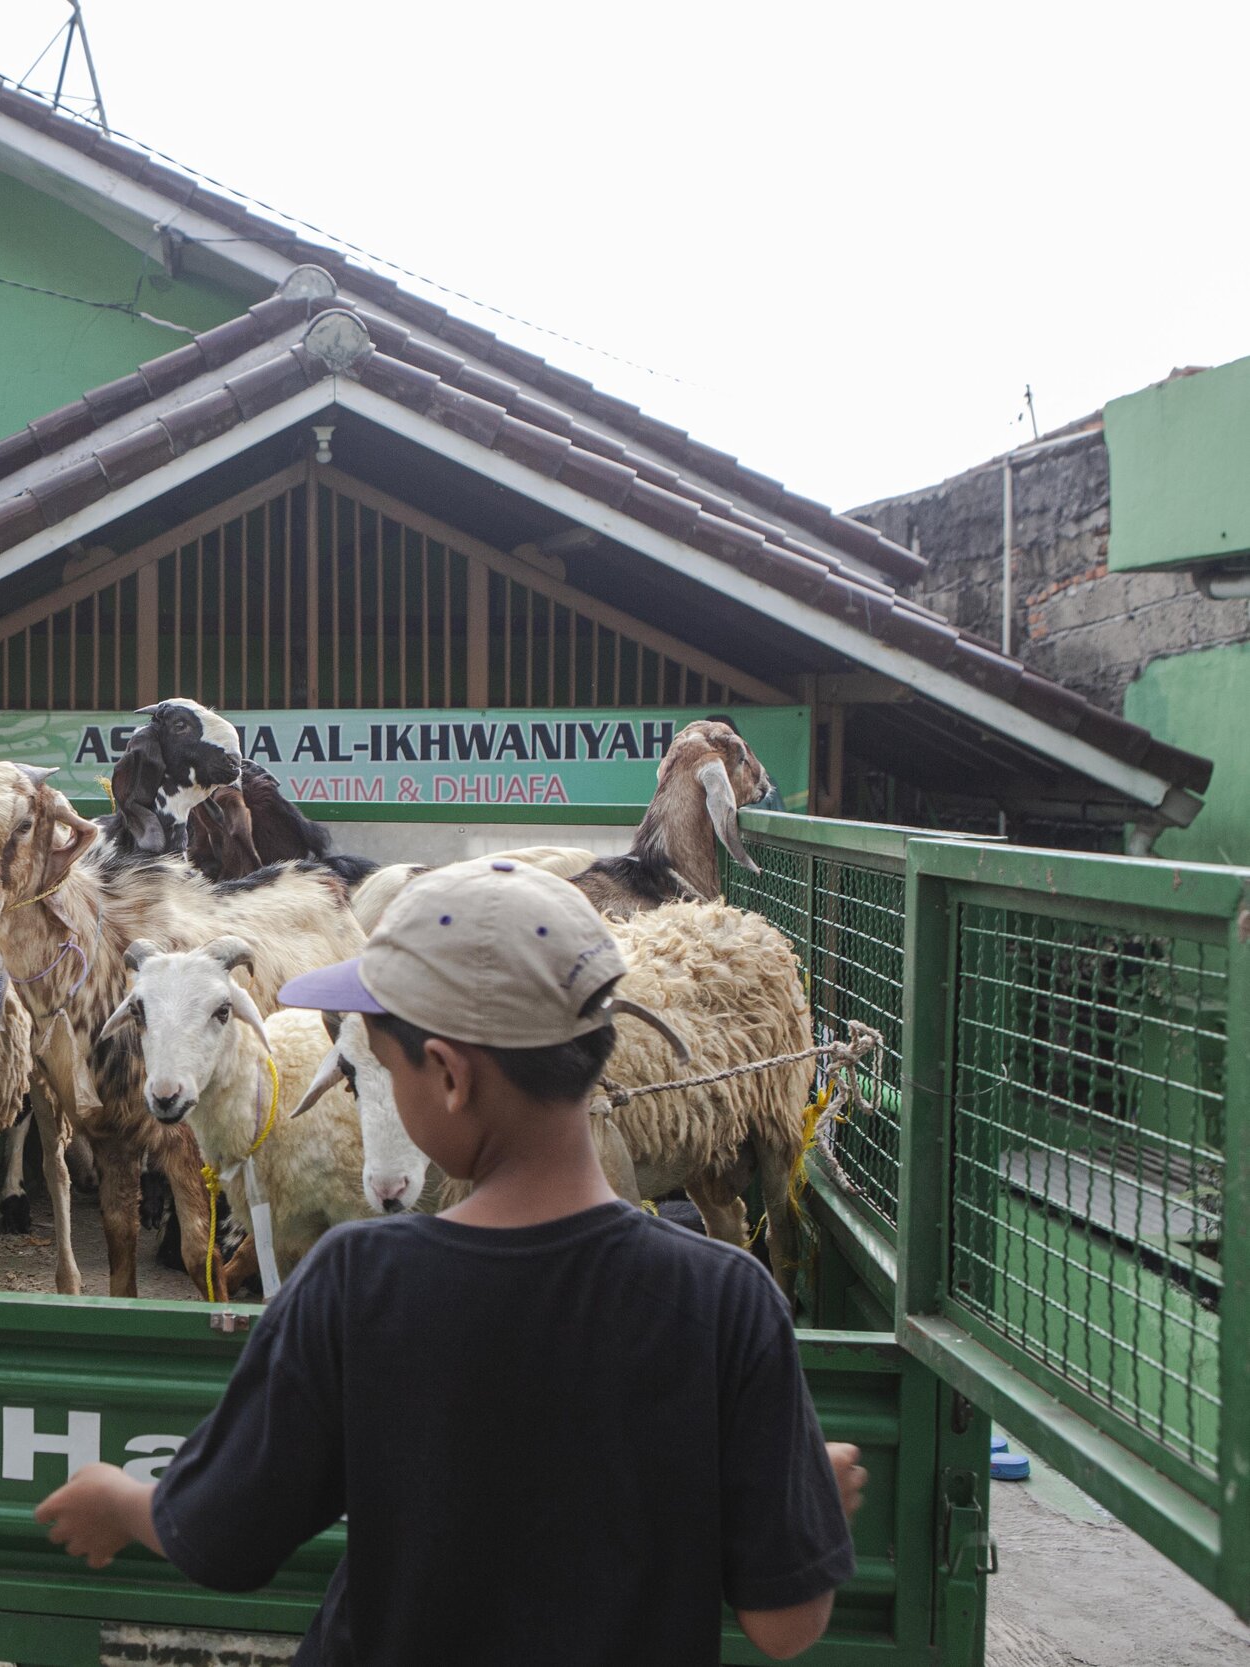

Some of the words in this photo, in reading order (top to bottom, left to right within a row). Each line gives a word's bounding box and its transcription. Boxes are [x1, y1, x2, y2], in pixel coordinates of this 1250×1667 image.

[292, 722, 675, 763] AL-IKHWANIYAH
[290, 776, 384, 802] YATIM
[398, 776, 421, 802] &
[434, 774, 568, 804] DHUAFA
